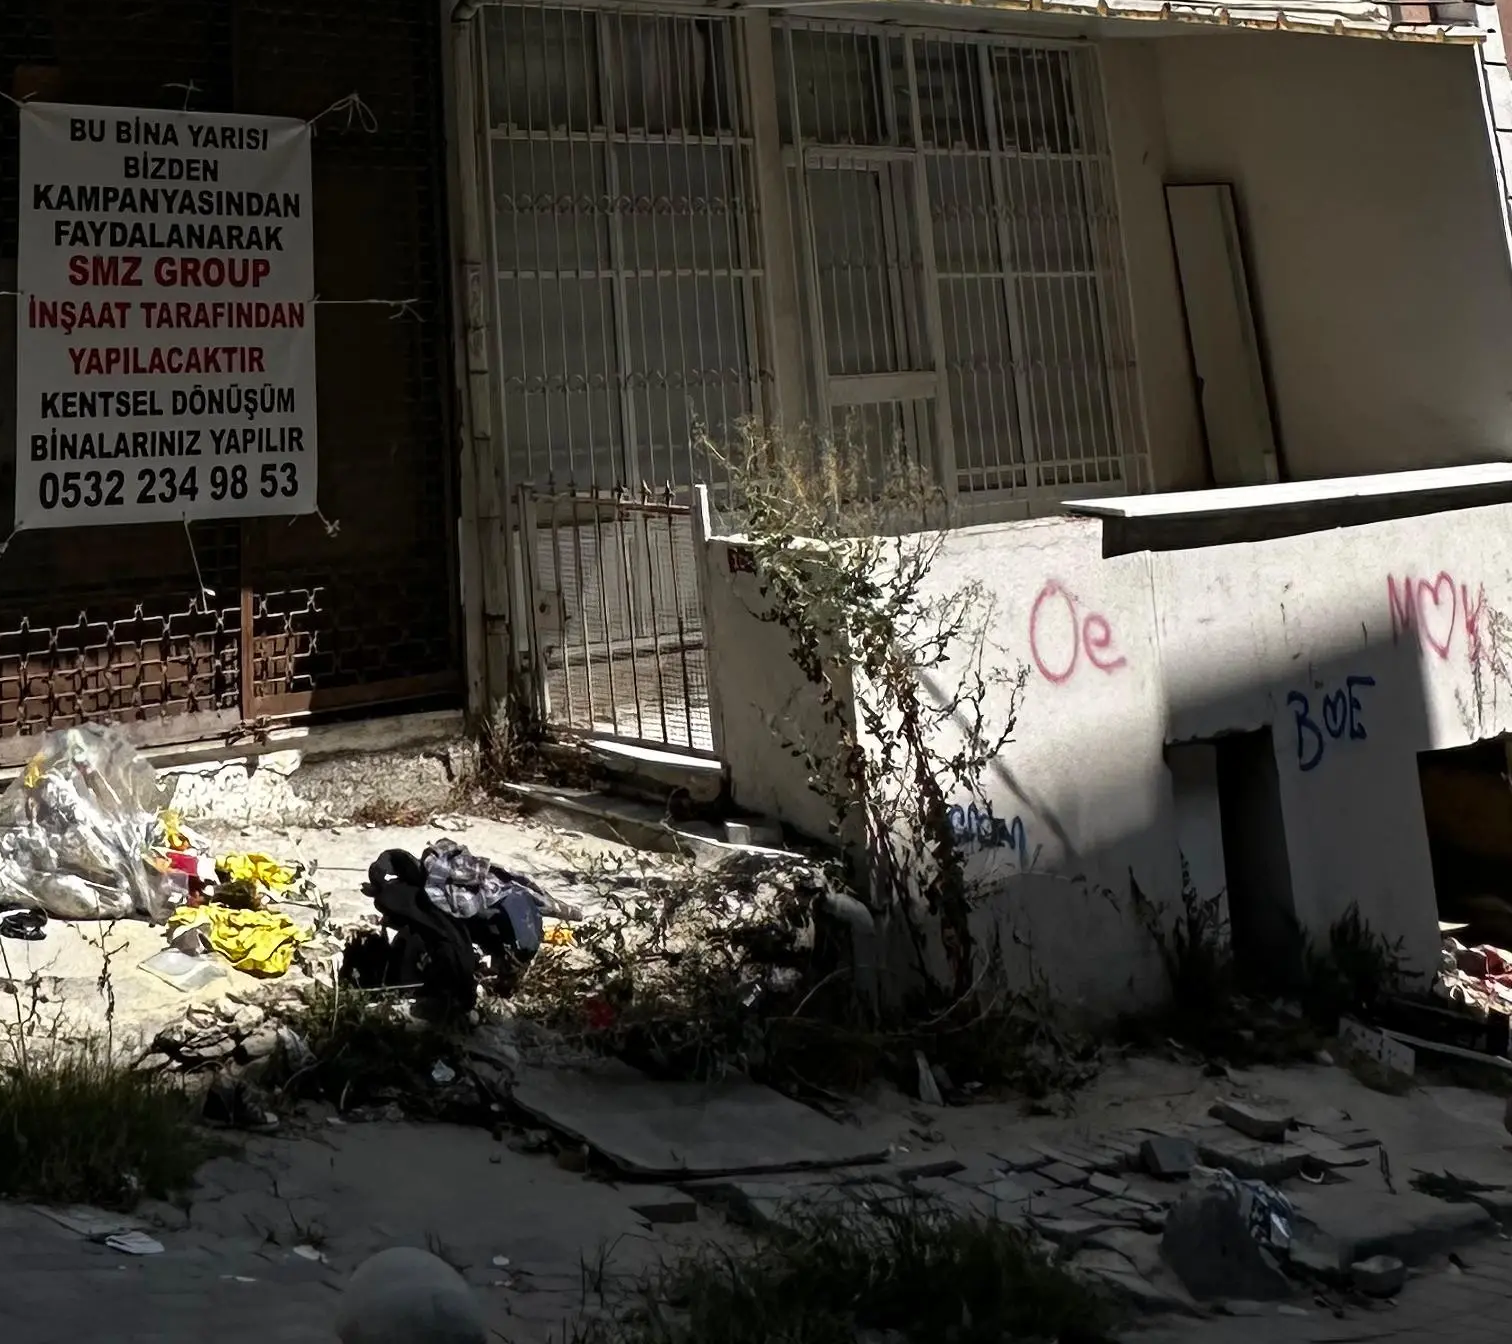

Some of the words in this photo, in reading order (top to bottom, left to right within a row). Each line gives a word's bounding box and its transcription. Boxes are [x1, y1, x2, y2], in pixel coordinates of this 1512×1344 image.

[70, 118, 106, 142] BU
[116, 116, 179, 146] BİNA
[188, 125, 269, 150] YARISI
[124, 151, 219, 182] BİZDEN
[33, 184, 301, 218] KAMPANYASINDAN
[54, 220, 284, 251] FAYDALANARAK
[68, 255, 143, 287] SMZ
[154, 257, 271, 288] GROUP
[28, 294, 131, 336] İNŞAAT
[140, 302, 305, 329] TARAFINDAN
[68, 346, 266, 376] YAPILACAKTIR
[41, 390, 164, 419] KENTSEL
[172, 383, 295, 420] DÖNÜŞÜM
[30, 427, 202, 462] BİNALARINIZ
[209, 427, 305, 455] YAPILIR
[38, 469, 125, 509] 0532
[136, 466, 199, 503] 234
[210, 464, 248, 501] 98
[260, 461, 299, 498] 53
